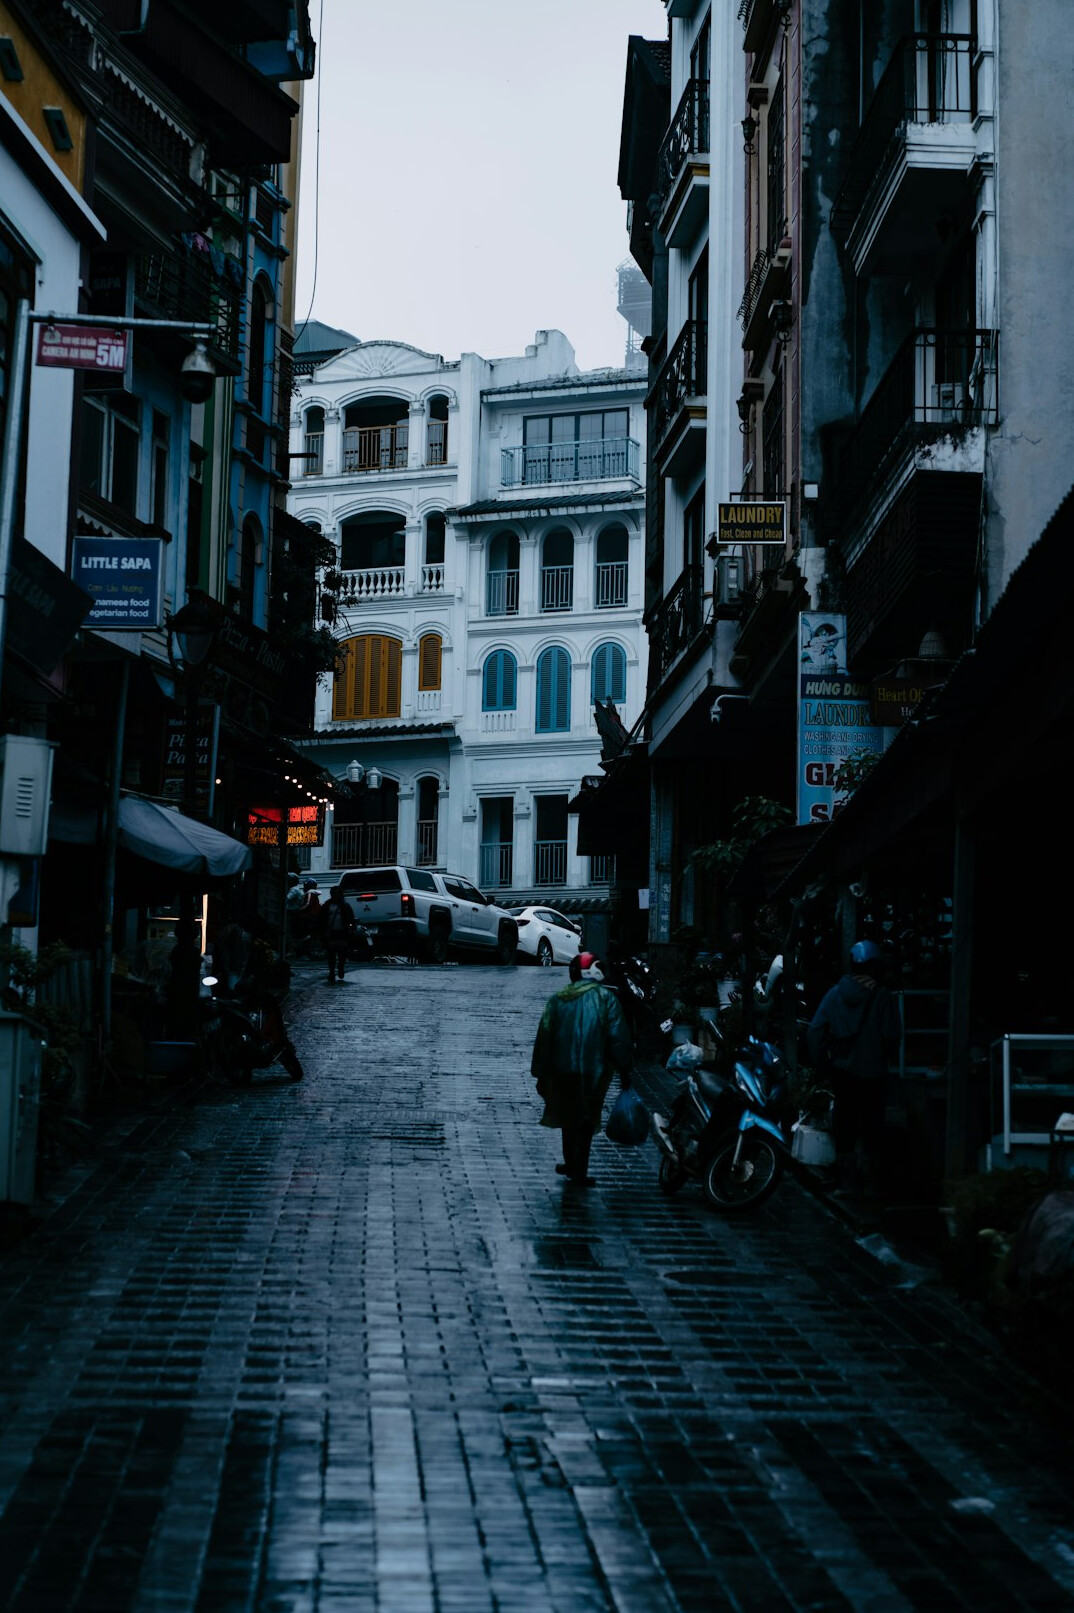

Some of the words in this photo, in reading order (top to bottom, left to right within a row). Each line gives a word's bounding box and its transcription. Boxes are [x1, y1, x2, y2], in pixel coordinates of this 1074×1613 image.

[96, 344, 125, 368] 5M
[720, 506, 782, 524] LAUNDRY
[735, 528, 752, 539] Clean
[753, 529, 764, 539] and
[765, 529, 782, 540] Cheap
[81, 556, 119, 569] LITTLE
[120, 557, 152, 570] SAPA
[94, 599, 129, 607] namese
[130, 599, 150, 607] food
[89, 609, 128, 618] egetarian
[129, 609, 149, 617] food
[878, 688, 906, 701] Heart
[805, 703, 871, 726] LAUNDR
[168, 733, 209, 748] Pia
[804, 731, 837, 742] WASHING
[838, 732, 852, 742] AND
[852, 733, 879, 743] DRYING
[804, 744, 836, 755] CLOTHES
[837, 745, 851, 756] AND
[165, 750, 209, 765] Paa
